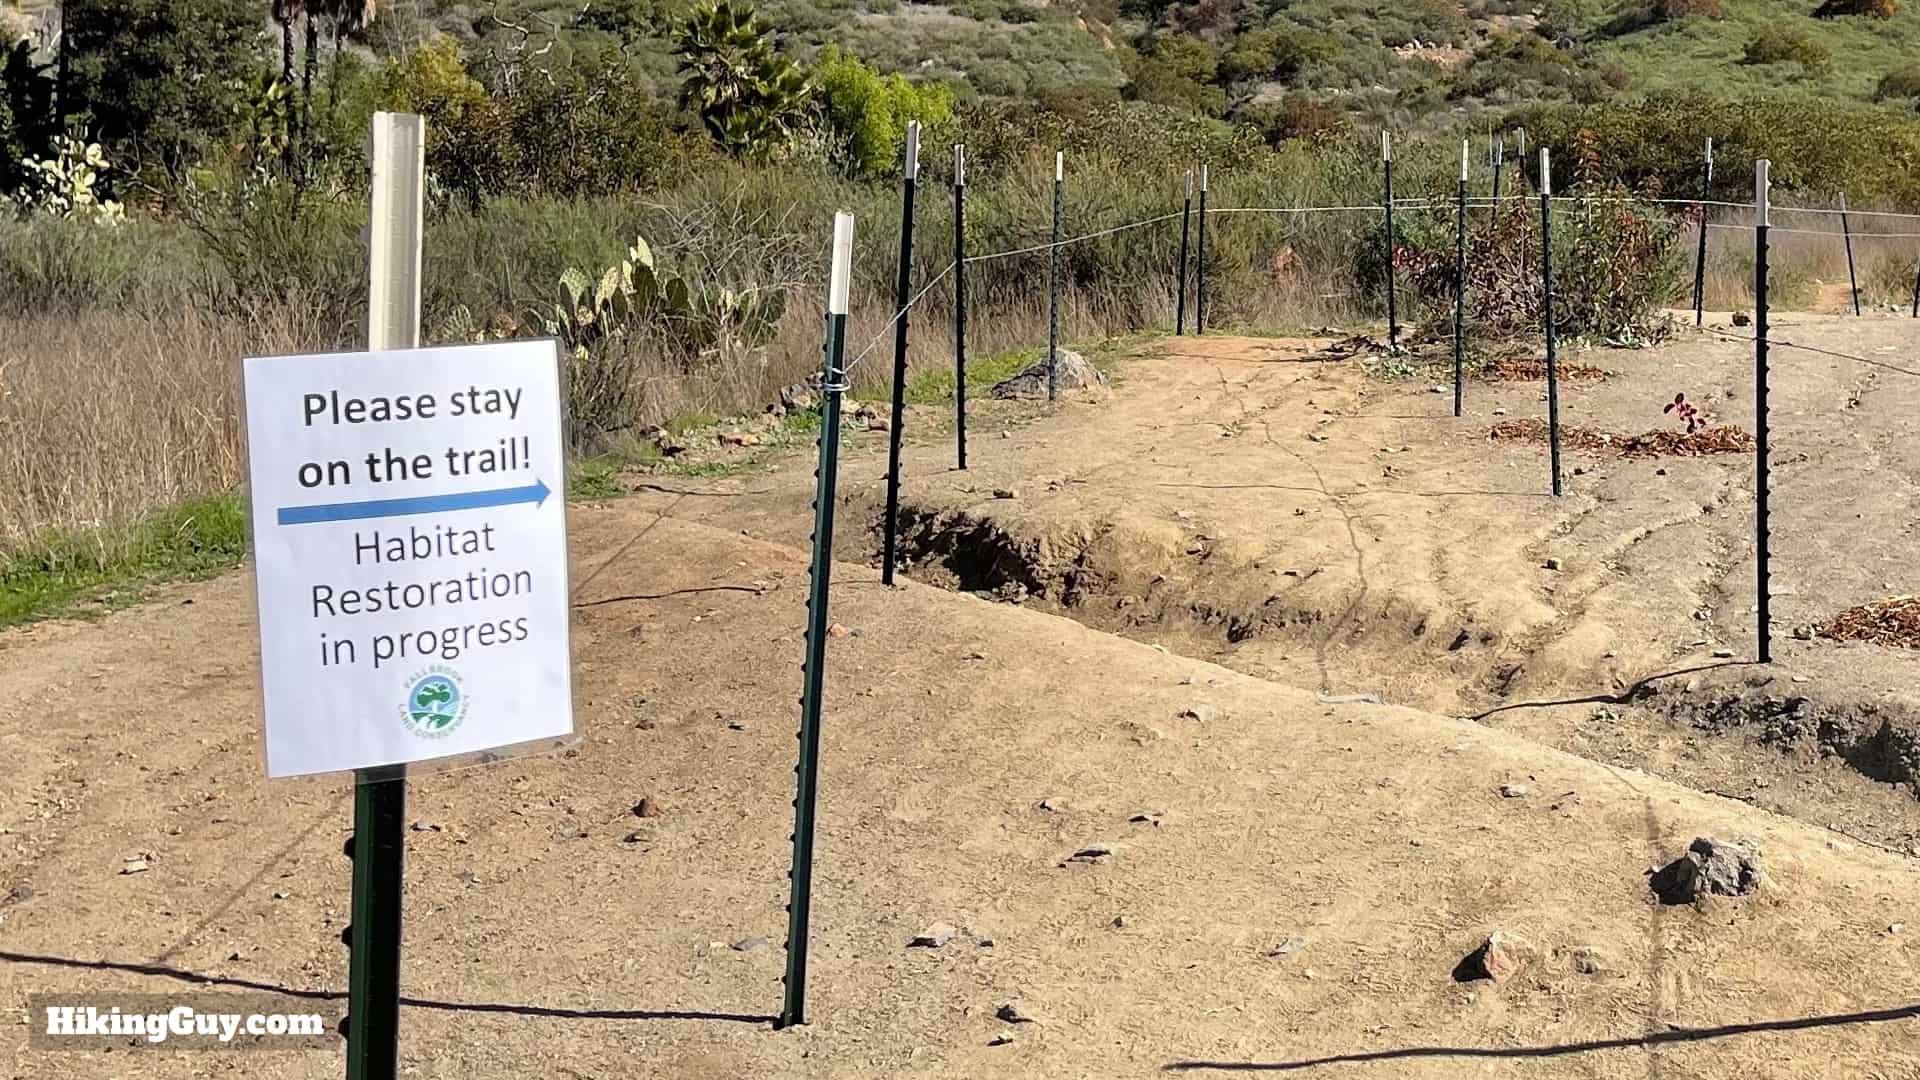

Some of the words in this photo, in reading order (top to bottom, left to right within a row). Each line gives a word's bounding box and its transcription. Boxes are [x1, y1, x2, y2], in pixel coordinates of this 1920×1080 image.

[303, 390, 436, 426] Please
[450, 386, 522, 420] stay
[298, 460, 351, 488] on
[364, 447, 433, 483] the
[445, 436, 530, 475] trail!
[354, 523, 495, 564] Habitat
[312, 567, 532, 618] Restoration
[320, 632, 355, 666] in
[373, 617, 529, 668] progress
